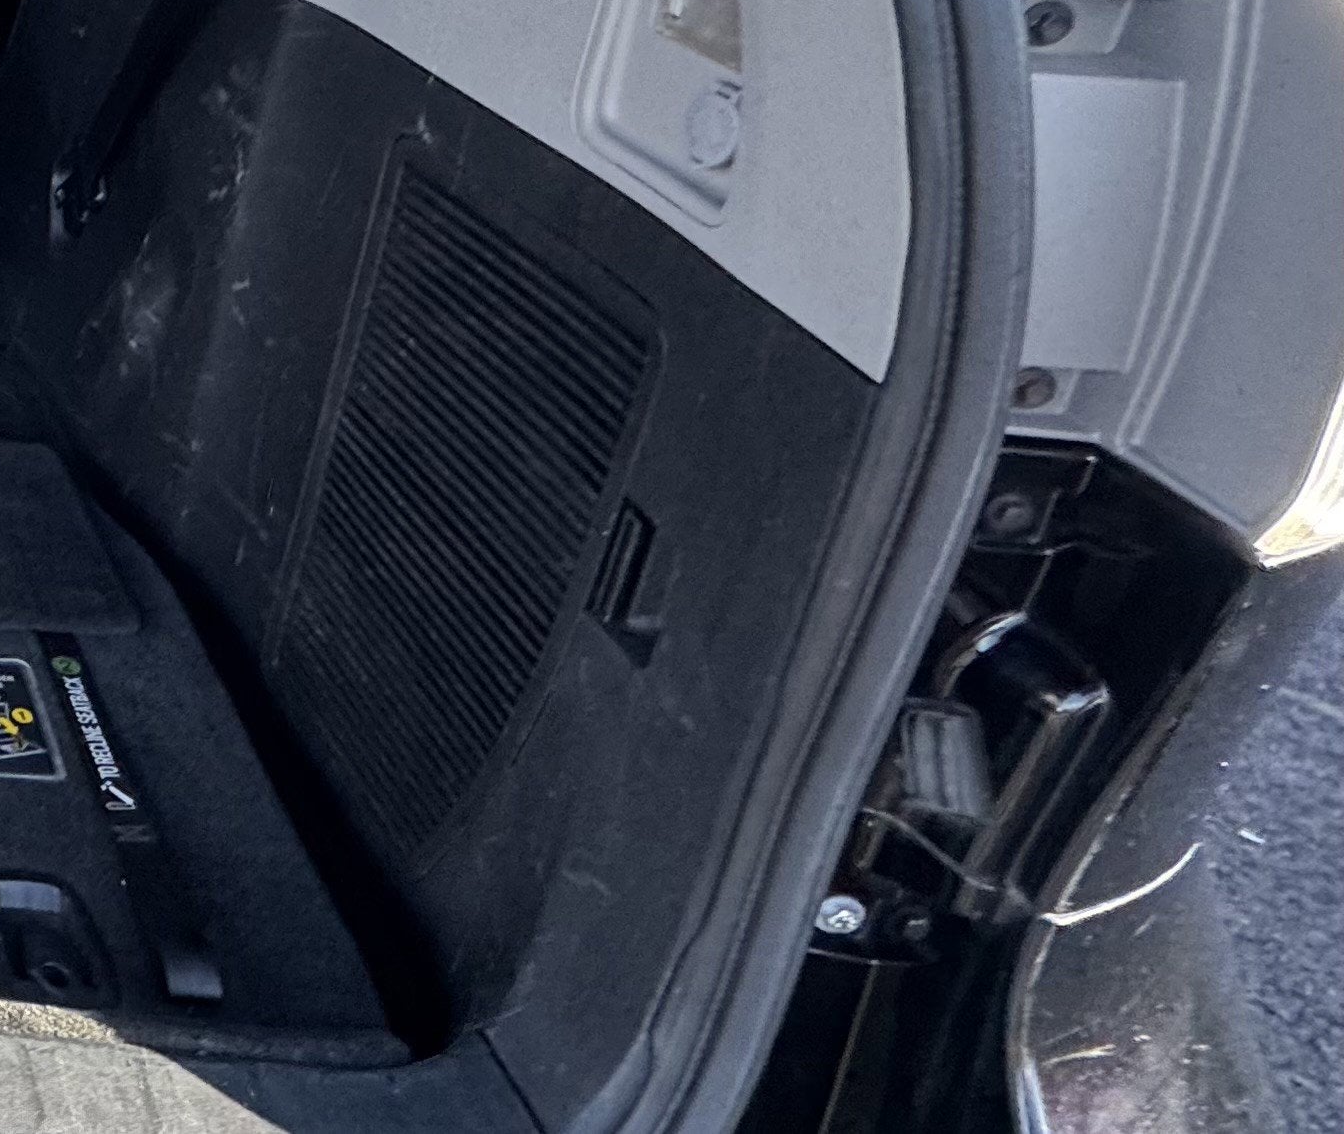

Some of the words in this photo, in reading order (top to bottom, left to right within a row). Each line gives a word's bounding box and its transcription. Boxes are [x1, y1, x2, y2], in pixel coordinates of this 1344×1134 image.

[63, 676, 99, 725] SEATBACK
[81, 725, 115, 765] RECLINE
[97, 766, 120, 779] TO
